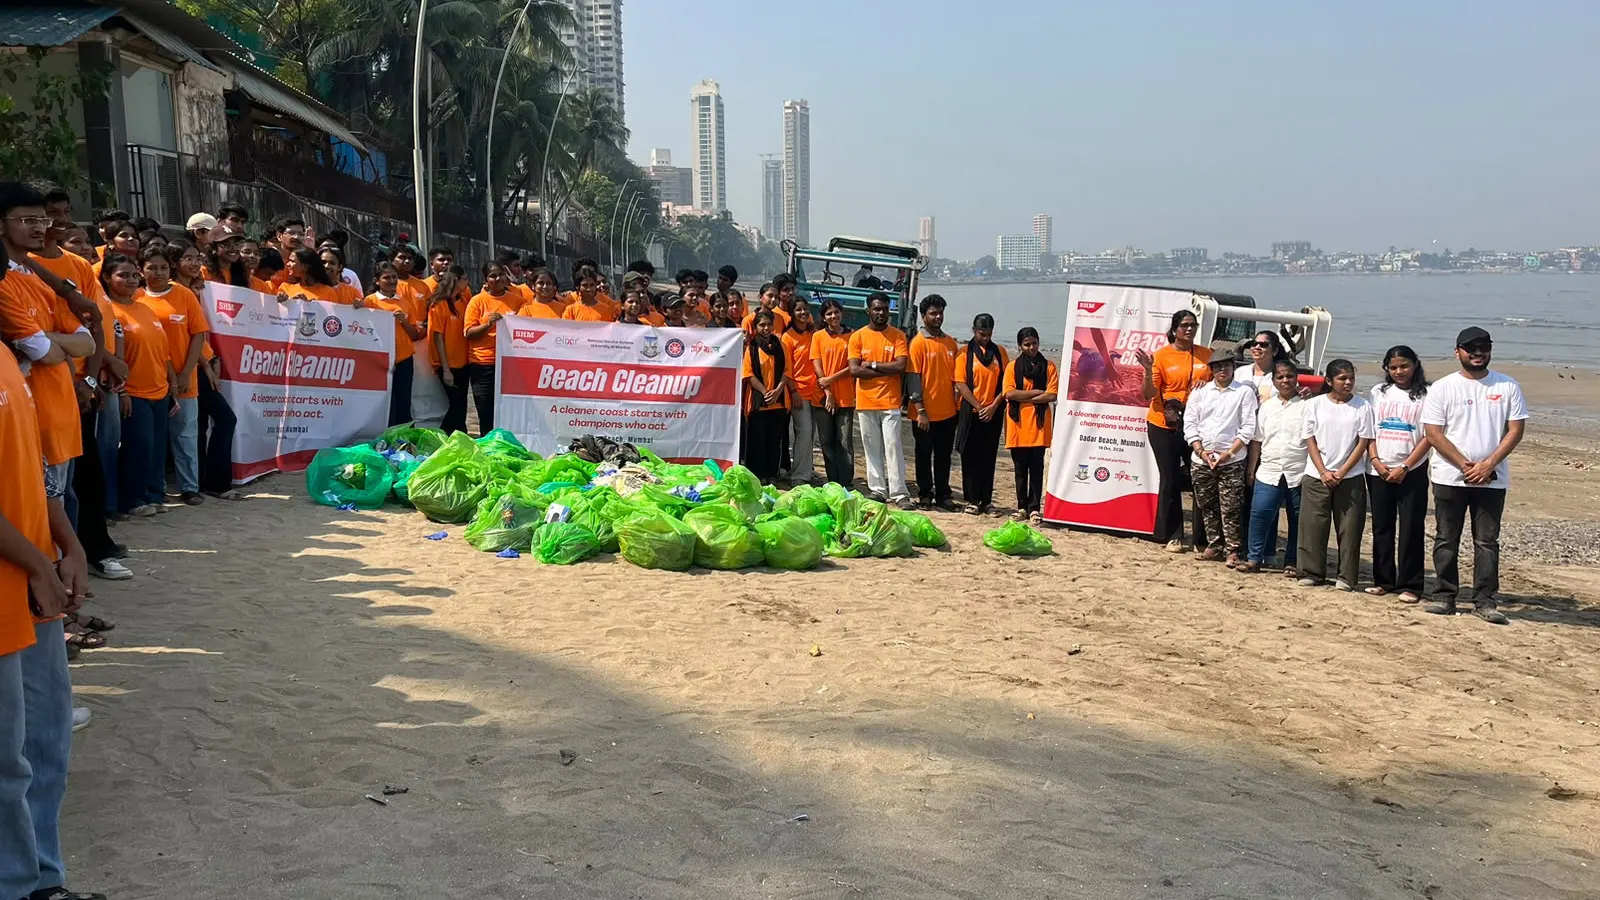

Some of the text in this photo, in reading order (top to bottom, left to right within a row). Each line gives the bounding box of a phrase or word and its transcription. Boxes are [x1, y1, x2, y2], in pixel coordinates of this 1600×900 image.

[1116, 306, 1140, 316] elixir
[515, 330, 535, 339] SHM
[555, 335, 580, 346] elixir
[1115, 329, 1168, 353] Beac
[240, 344, 356, 385] Beach Cleanup
[537, 365, 702, 399] Beach Cleanup
[251, 391, 257, 402] A
[322, 397, 343, 406] with
[304, 409, 324, 419] act.
[550, 405, 687, 419] A cleaner coast starts with
[1074, 410, 1100, 418] cleaner
[568, 418, 668, 430] champions who act.
[1080, 420, 1117, 429] champions
[1079, 434, 1145, 448] Dadar Beach, Mumbai
